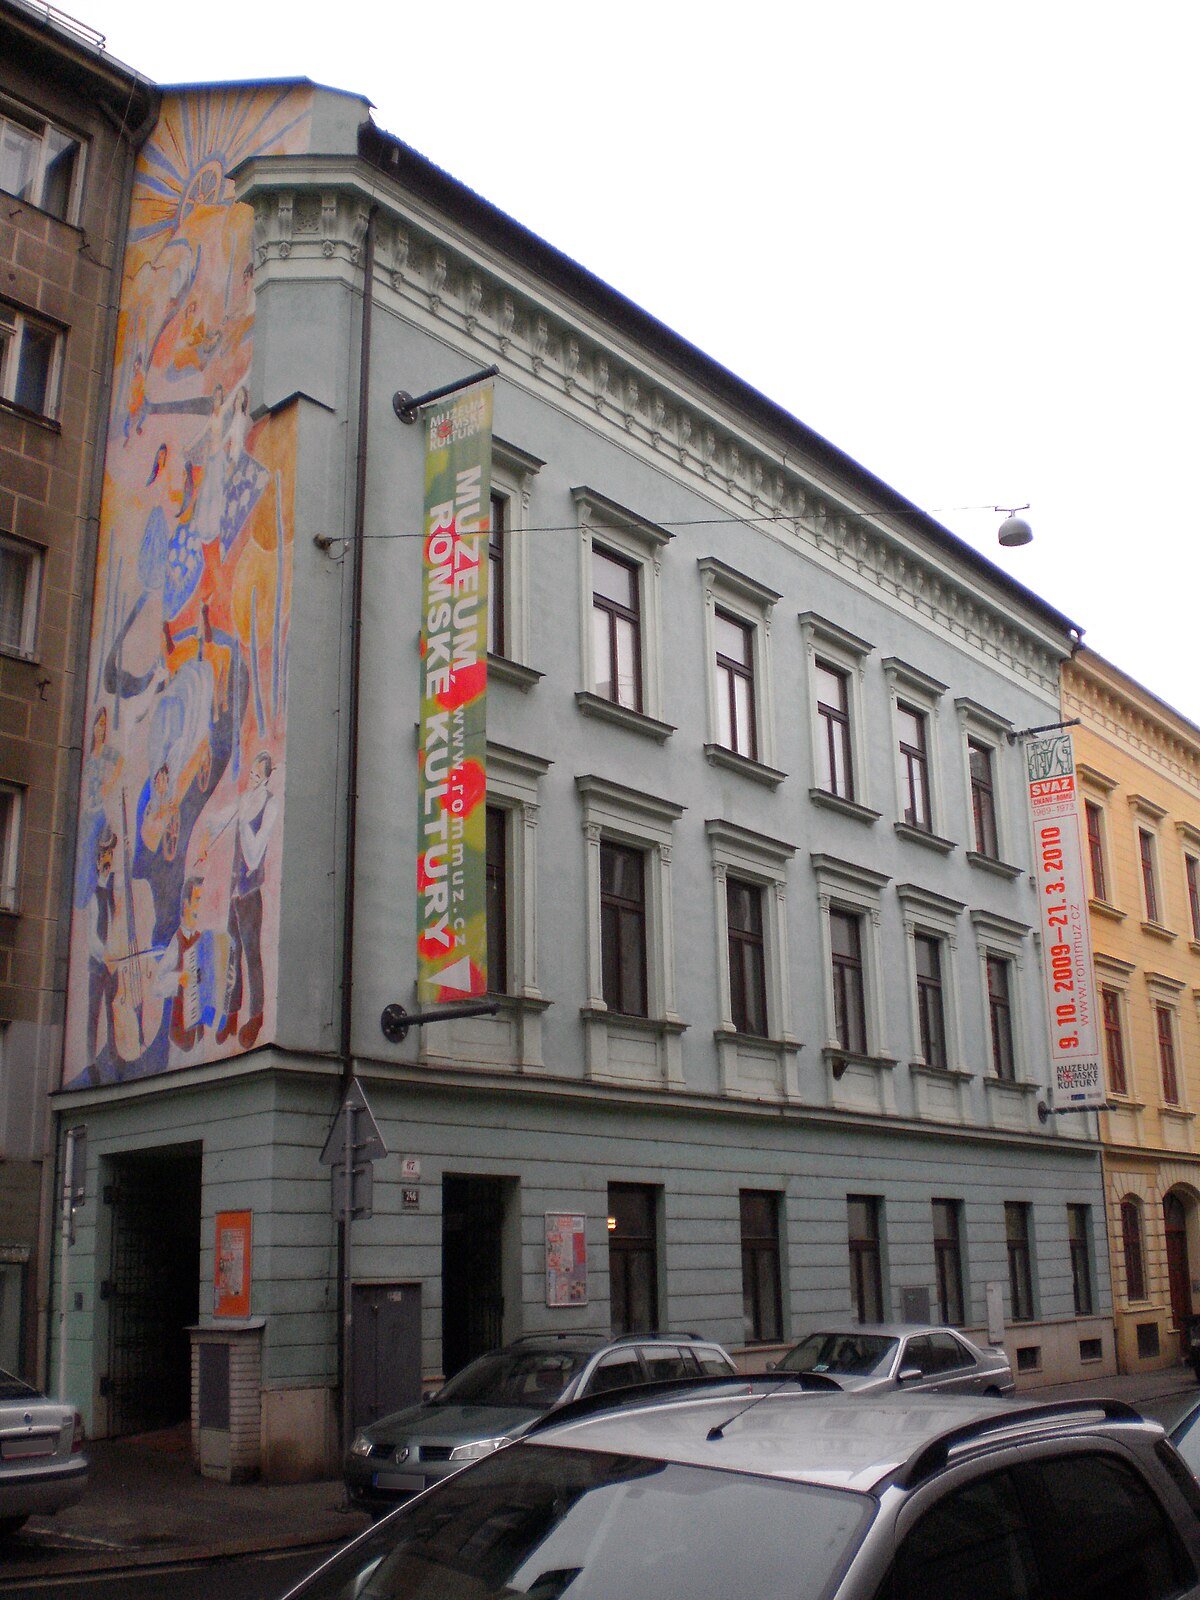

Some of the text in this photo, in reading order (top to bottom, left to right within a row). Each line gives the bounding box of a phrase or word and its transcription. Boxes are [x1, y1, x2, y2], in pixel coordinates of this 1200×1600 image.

[430, 424, 481, 451] KULTURY
[453, 465, 482, 671] MUZEUM
[423, 500, 455, 949] ROMSKÉ KULTURY
[1031, 779, 1071, 796] SVAZ
[451, 703, 466, 947] www.rommuz.cz
[1040, 826, 1063, 873] 2010
[1045, 876, 1065, 894] 3.
[1071, 904, 1089, 1027] www.rommuz.cz
[1057, 997, 1077, 1028] 10.
[1059, 1031, 1079, 1050] 9.
[1057, 1063, 1098, 1074] MUZEUM
[1058, 1079, 1098, 1090] KULTURY
